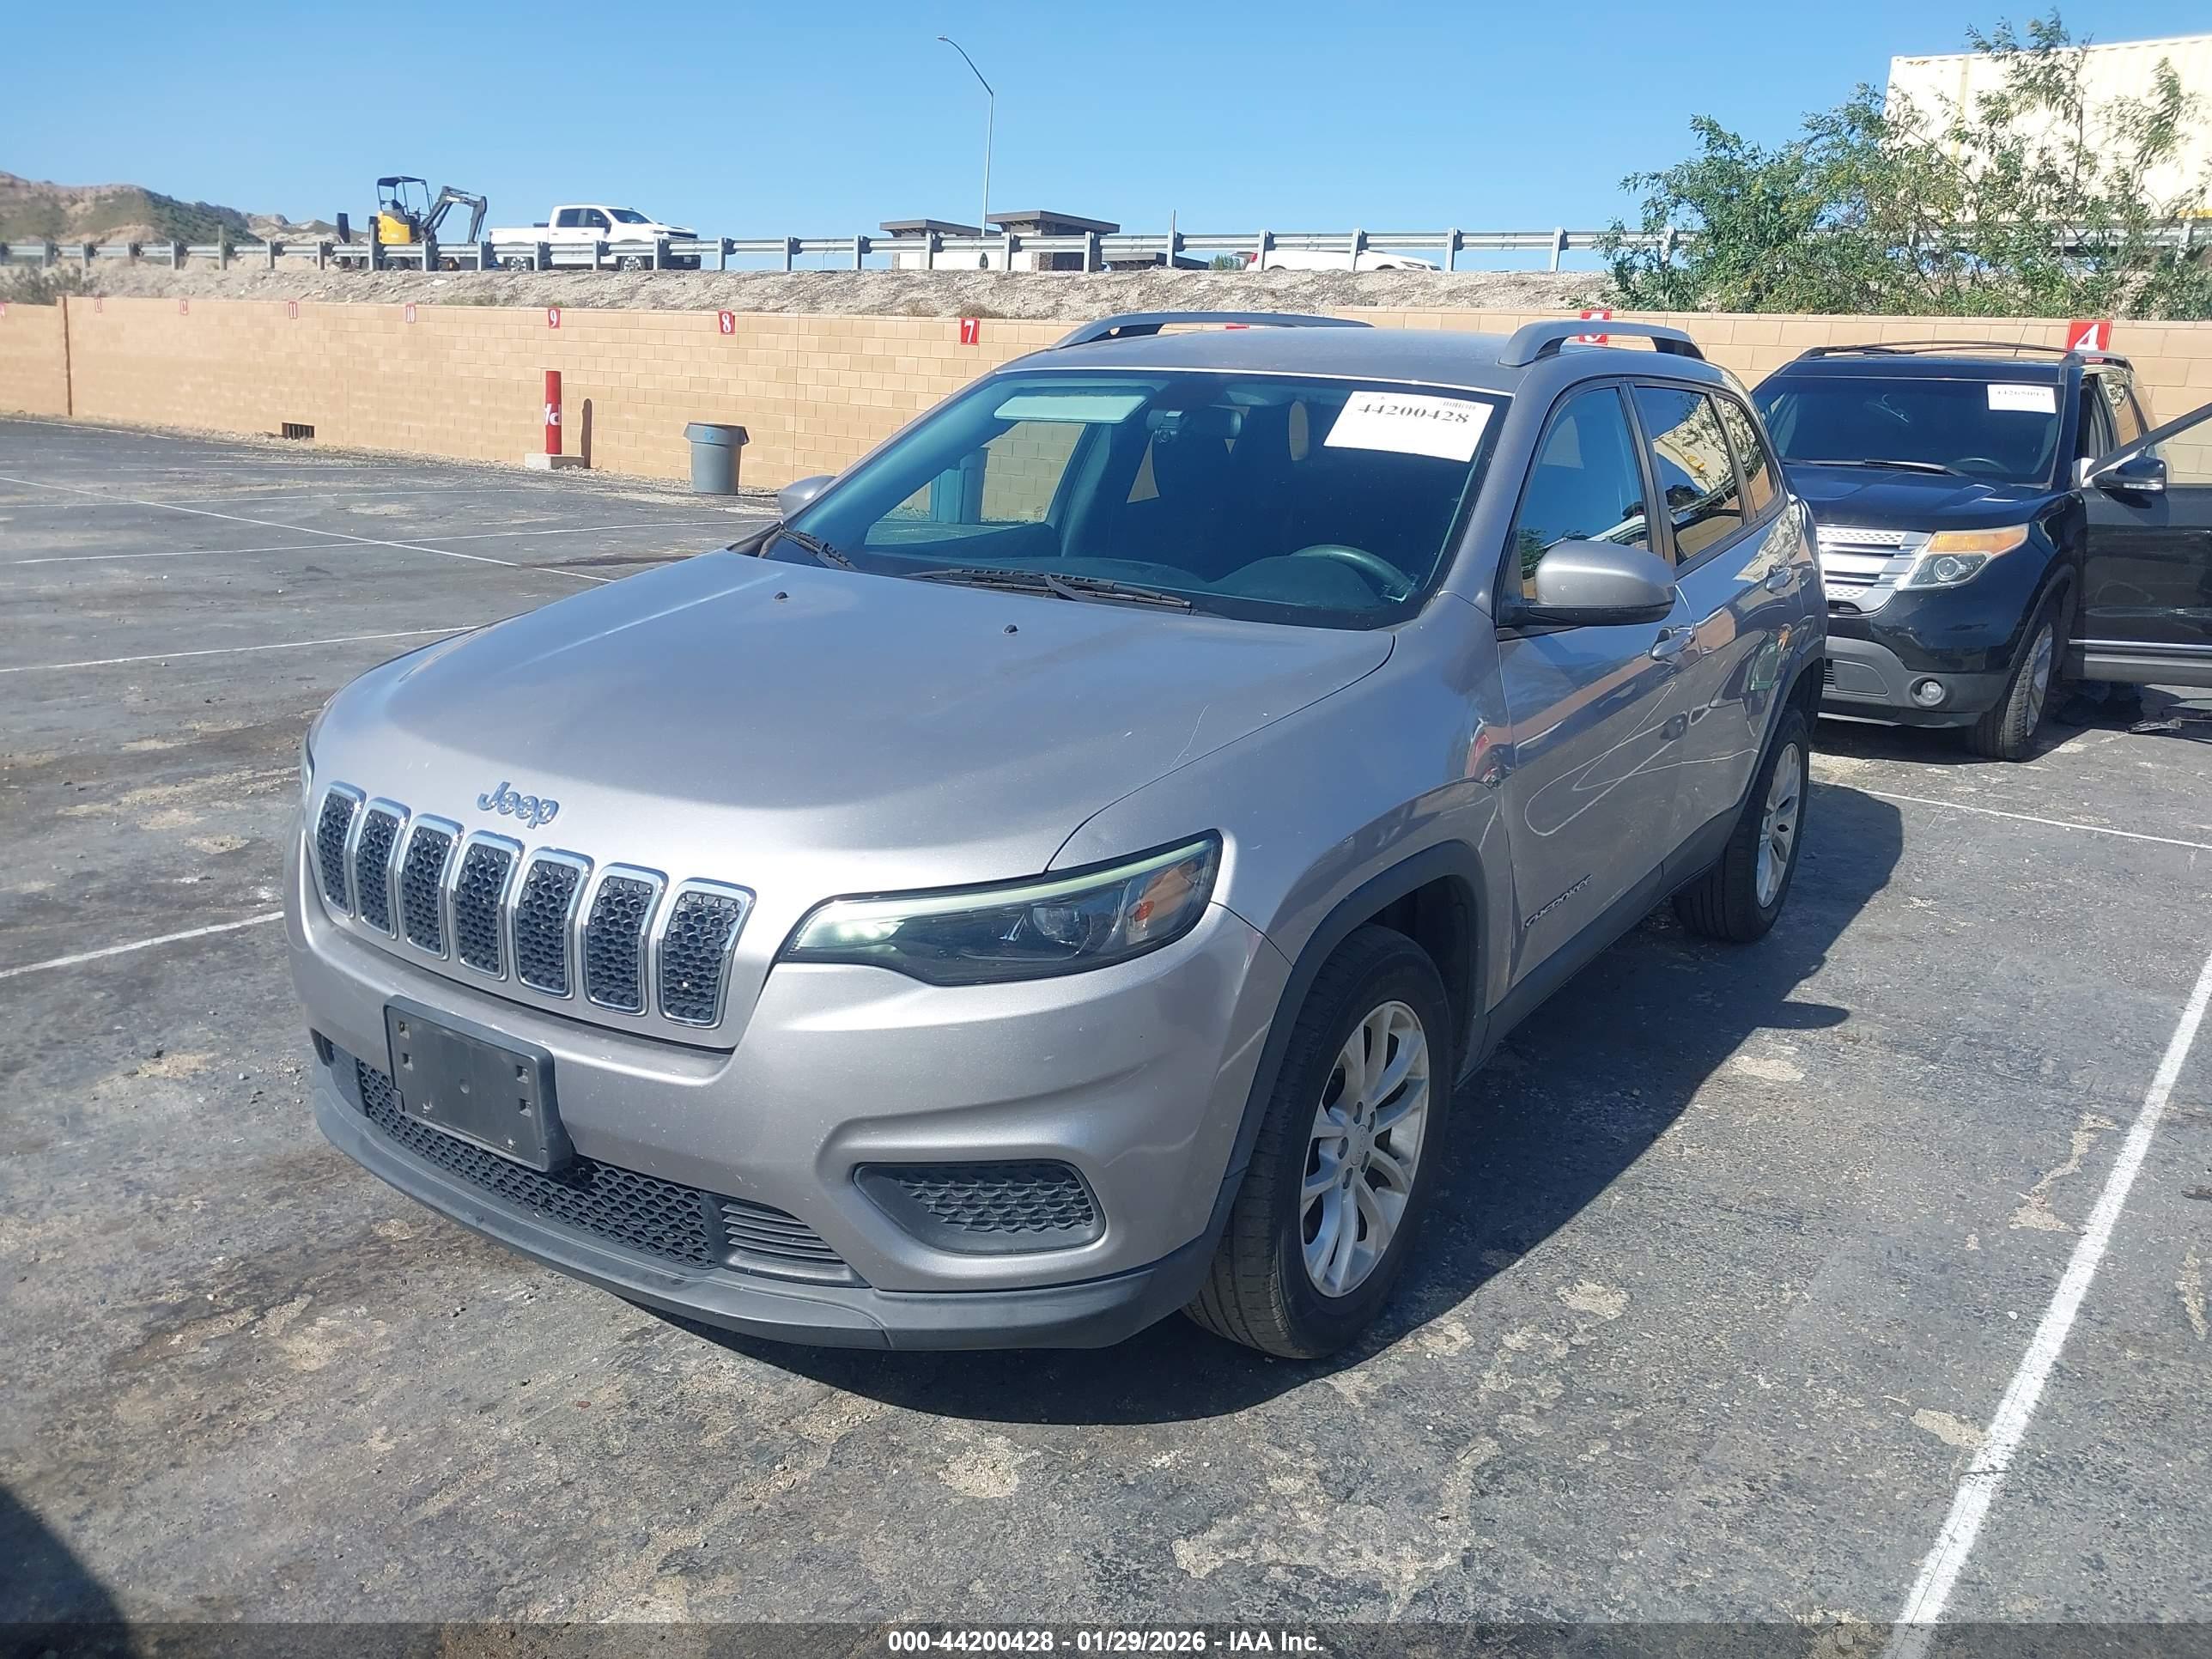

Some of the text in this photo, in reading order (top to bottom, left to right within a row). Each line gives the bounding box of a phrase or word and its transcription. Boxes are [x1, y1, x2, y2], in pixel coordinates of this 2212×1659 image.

[405, 305, 416, 324] 10
[549, 309, 558, 328] 9
[721, 313, 732, 333] 8
[963, 319, 975, 343] 7
[2074, 323, 2100, 350] 4
[1358, 404, 1470, 423] 44200428
[477, 781, 560, 830] Jeep
